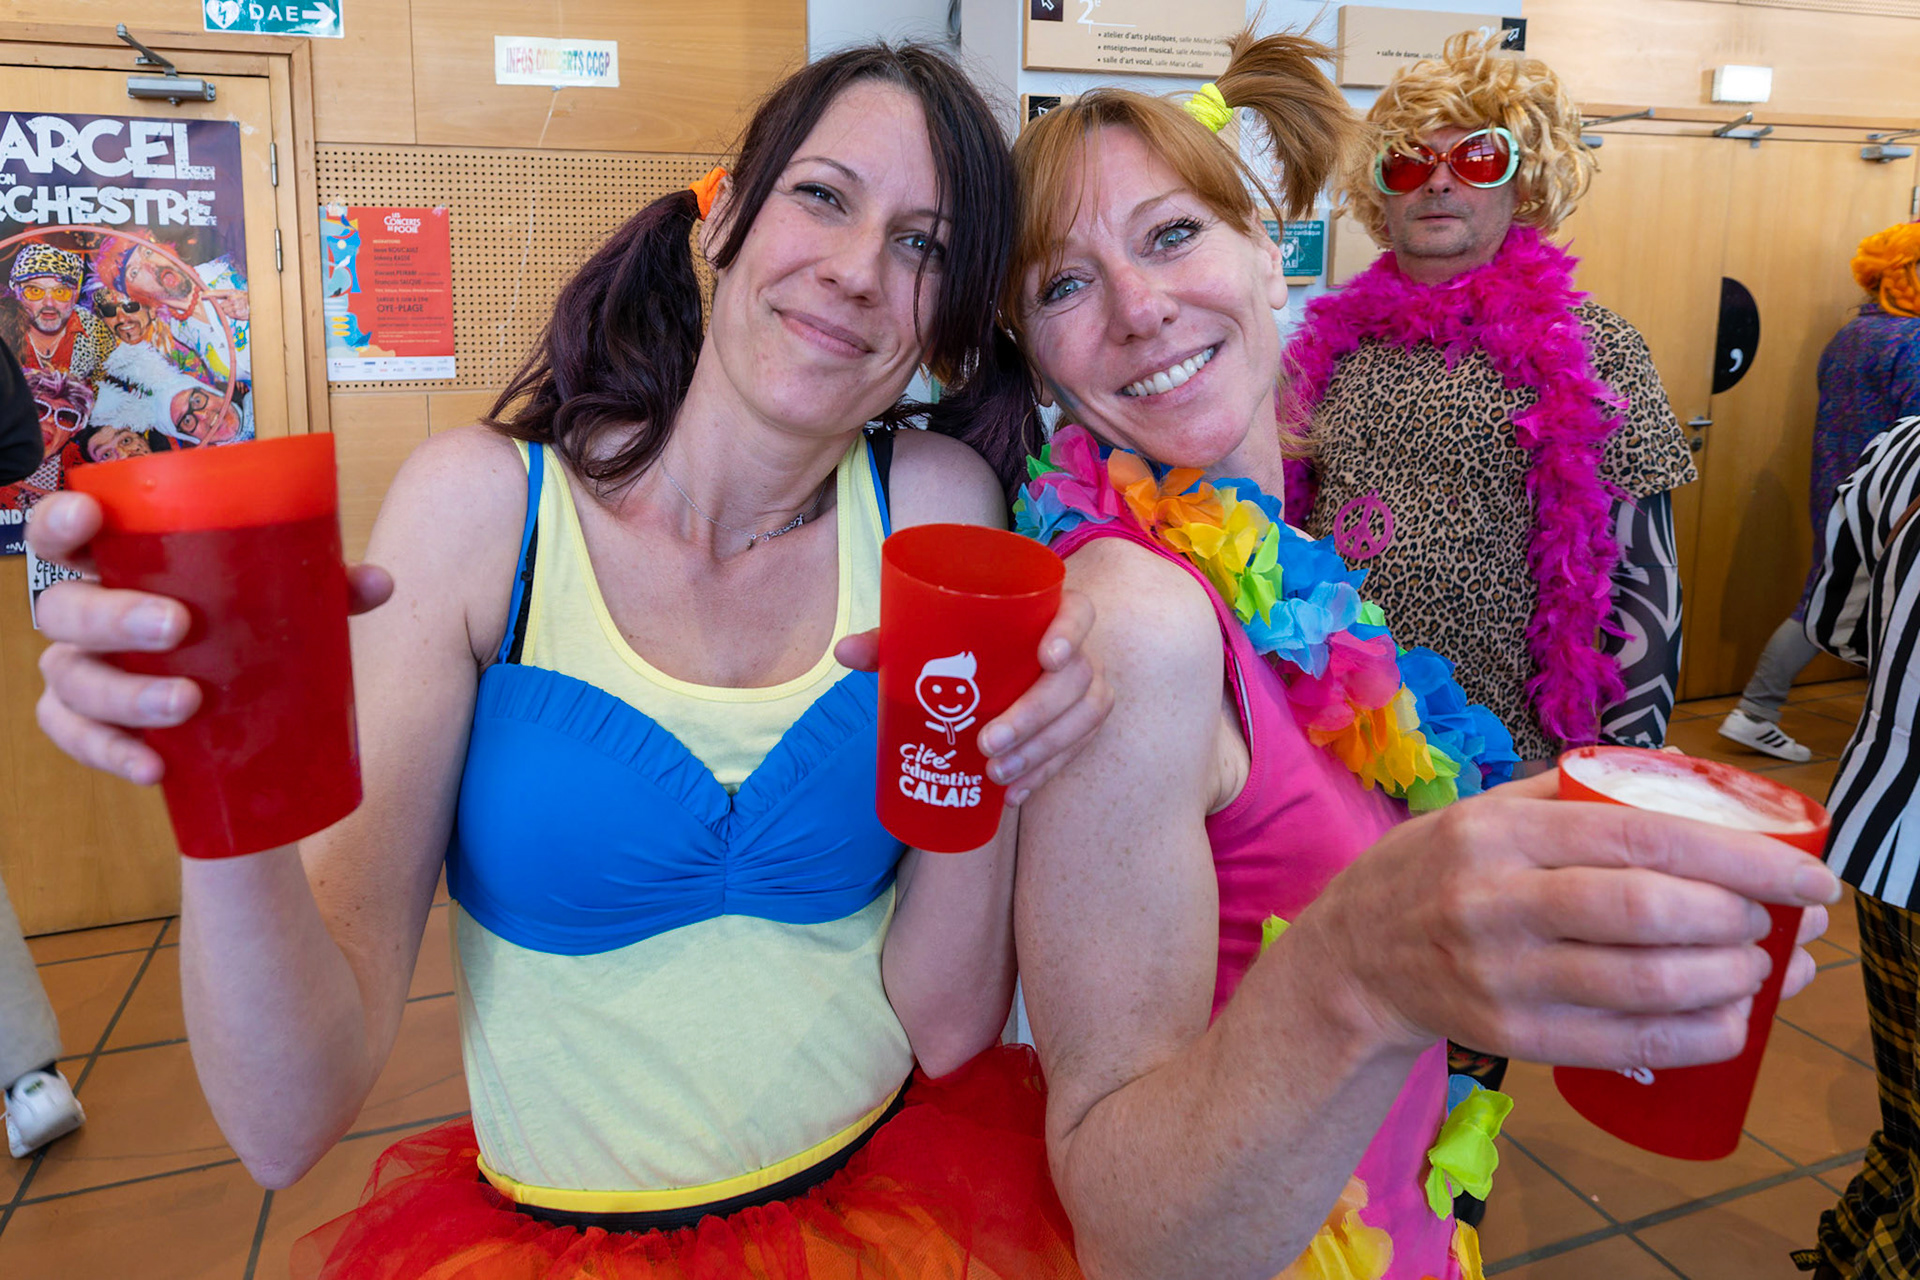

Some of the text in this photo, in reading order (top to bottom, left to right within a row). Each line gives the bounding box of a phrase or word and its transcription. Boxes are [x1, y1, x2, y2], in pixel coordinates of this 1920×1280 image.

[248, 3, 299, 22] DAE
[1103, 31, 1124, 39] atelier
[1125, 32, 1143, 40] d'arts
[505, 47, 534, 74] INFOS
[586, 50, 611, 77] CCGP
[376, 304, 424, 313] OYE-PLAGE
[900, 743, 957, 770] Cité
[901, 758, 983, 787] éducative
[899, 775, 982, 808] CALAIS
